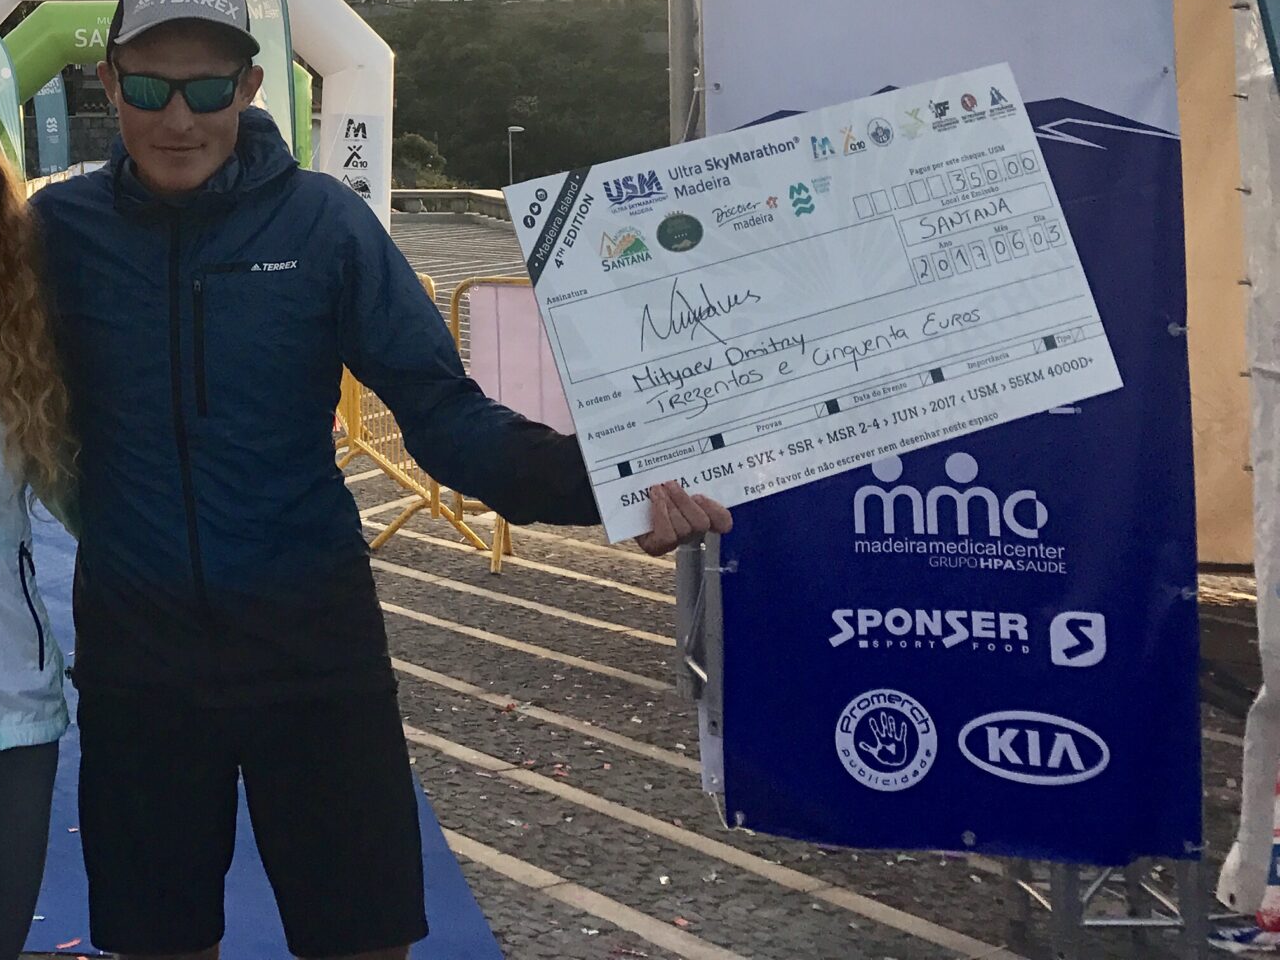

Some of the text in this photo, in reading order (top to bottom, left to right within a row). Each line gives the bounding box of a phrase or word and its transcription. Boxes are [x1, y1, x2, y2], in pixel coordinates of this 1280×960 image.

[668, 163, 703, 181] Ultra
[909, 165, 931, 176] Pague
[603, 170, 663, 203] USM
[674, 175, 731, 199] Madeira
[971, 186, 999, 198] Emissão
[536, 182, 578, 261] Madeira Island
[564, 193, 594, 248] EDITION
[733, 212, 774, 231] madeira
[920, 198, 1012, 240] SANTANA
[263, 260, 297, 271] TERREX
[602, 252, 652, 272] SANTANA
[546, 289, 588, 305] Assinatura
[632, 357, 712, 392] Mityaev
[882, 381, 907, 396] Evento
[586, 394, 611, 406] ordem
[700, 356, 1094, 483] USM SVK SSR MSR 2-4 JUN 2017 USM 55KM 4000D+
[756, 419, 783, 433] Provas
[595, 425, 625, 438] quantia
[644, 445, 695, 466] Internacional
[744, 411, 999, 497] Faça favor escrever nem desenhar neste espaço
[828, 607, 1029, 649] SPONSER
[985, 726, 1086, 771] KIA
